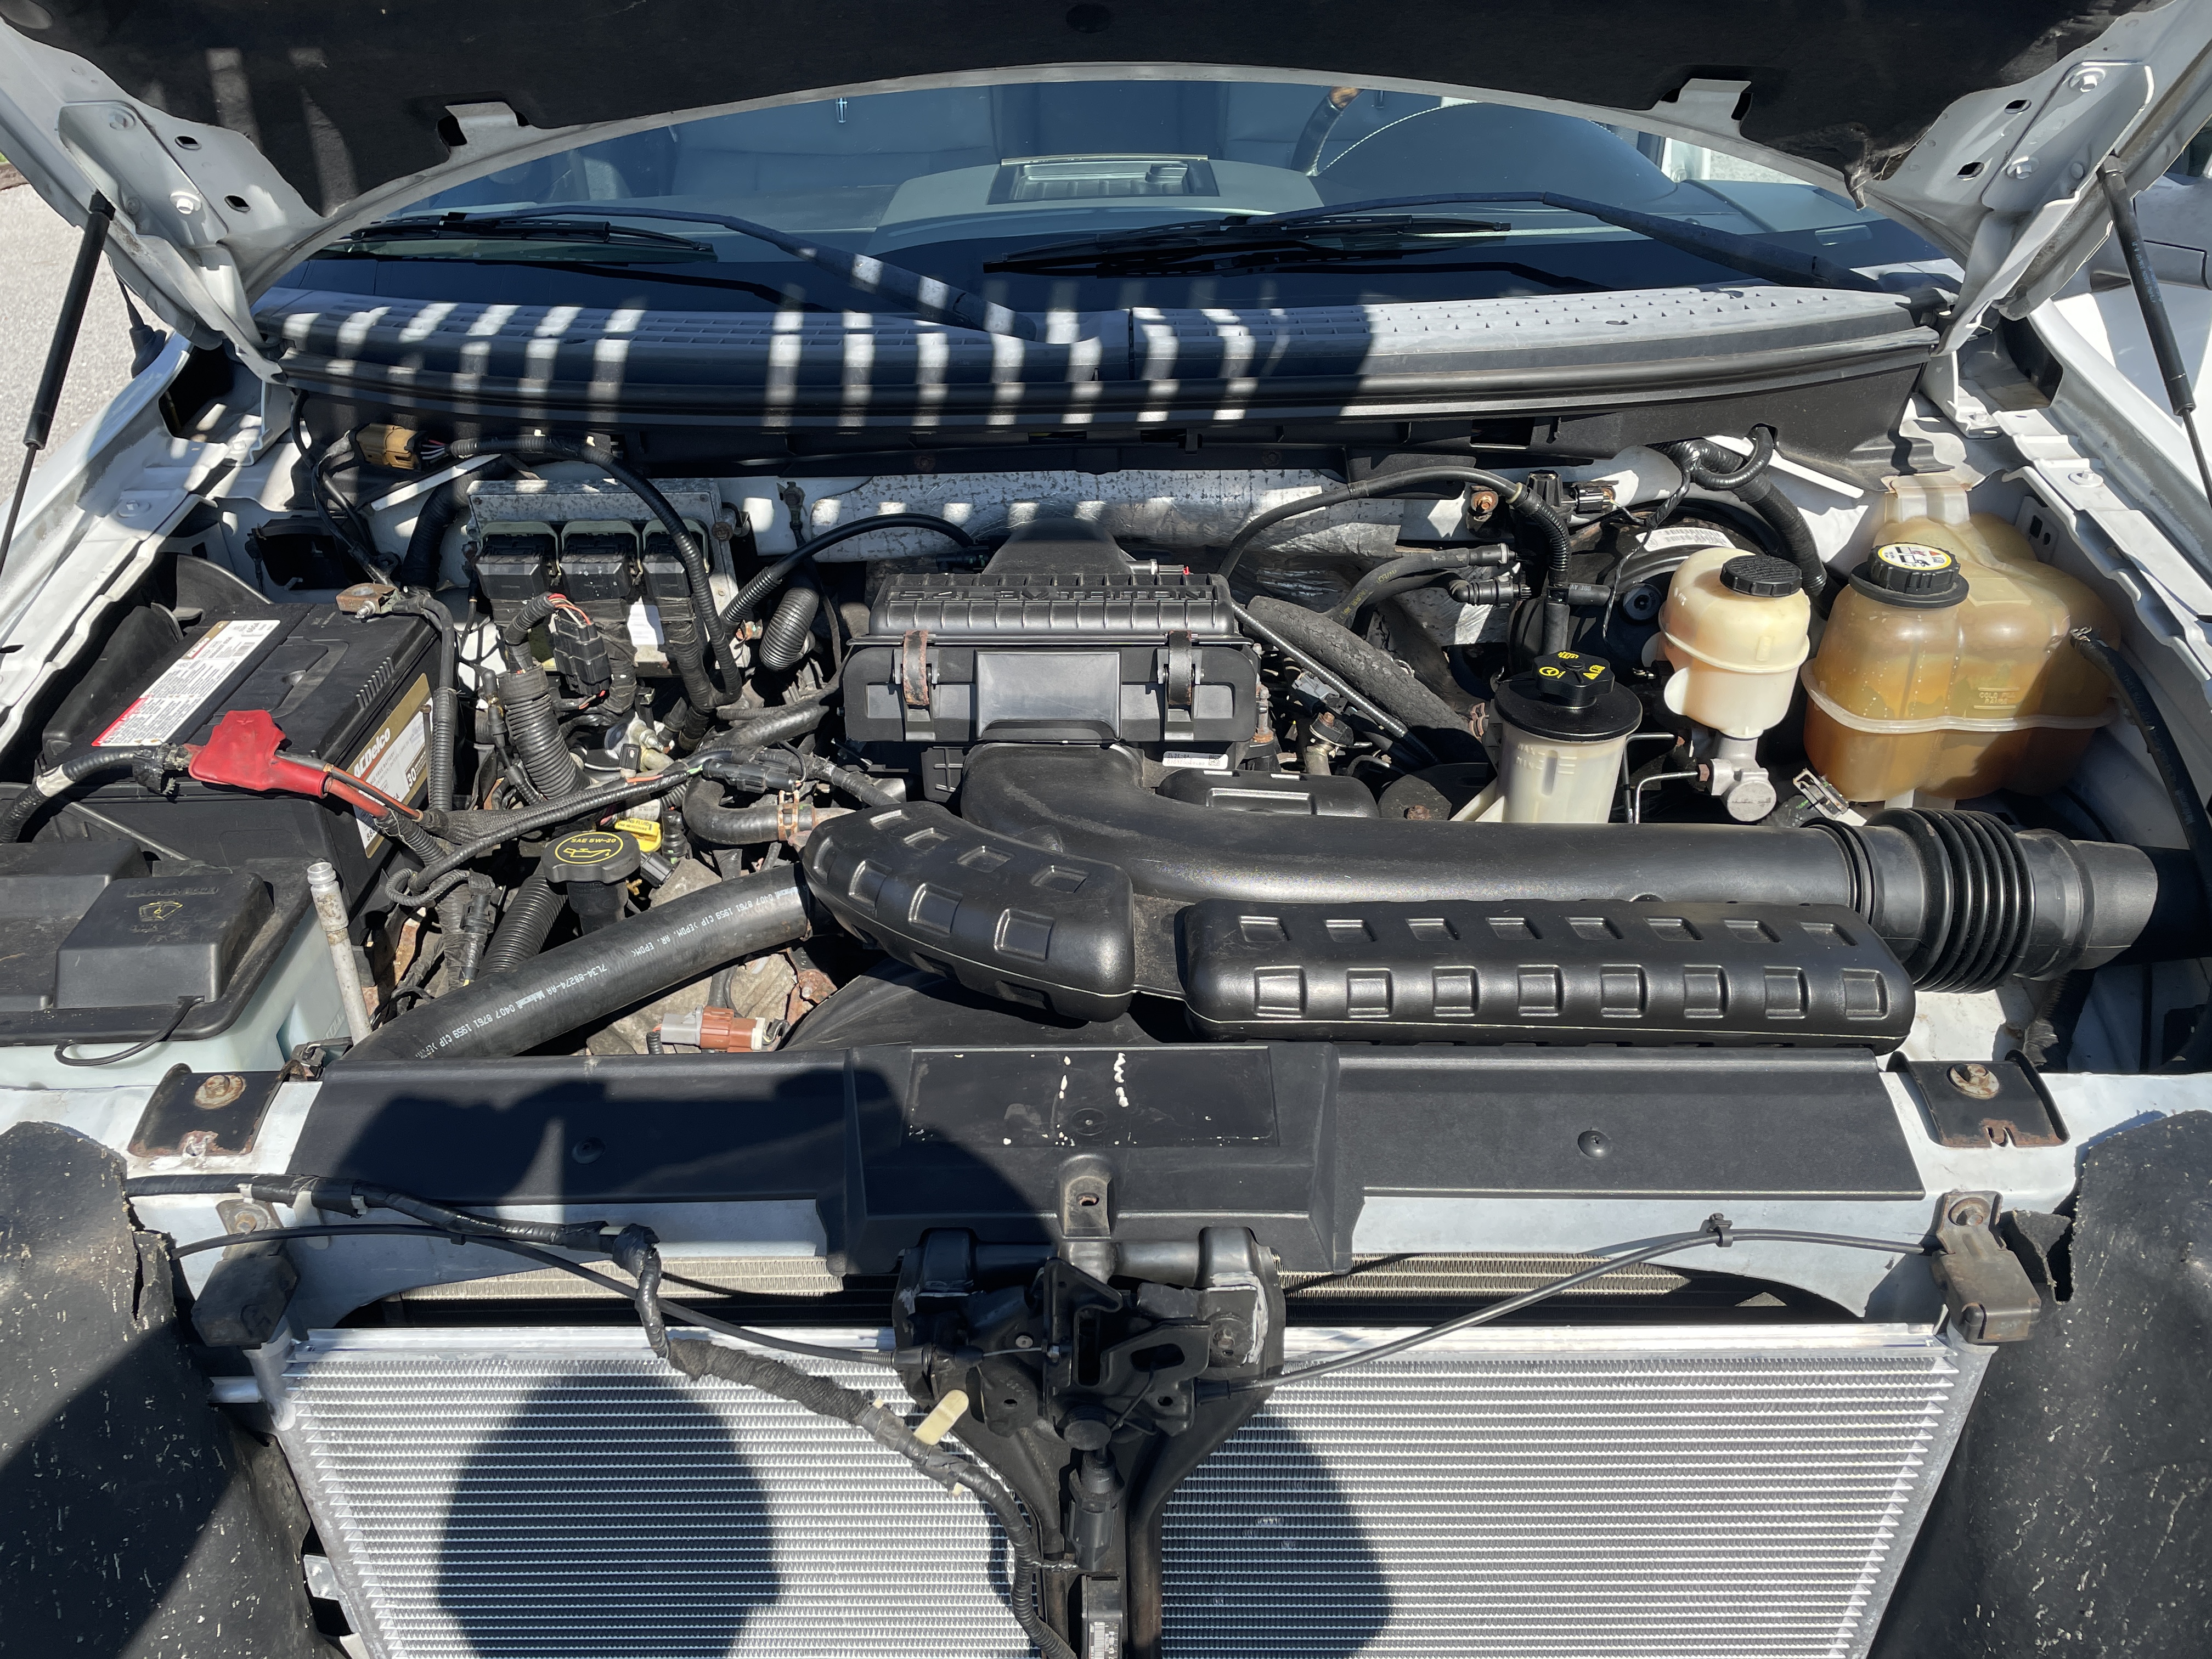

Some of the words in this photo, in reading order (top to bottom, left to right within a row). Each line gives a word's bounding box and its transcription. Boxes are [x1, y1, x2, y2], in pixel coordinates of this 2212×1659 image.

[899, 590, 984, 601] 5.4L
[994, 590, 1049, 601] 3V
[1056, 590, 1206, 601] TRITON
[354, 727, 391, 778] ACDelco
[1517, 743, 1536, 755] MAX
[1516, 756, 1534, 770] MIN
[407, 767, 416, 787] 30
[756, 894, 774, 902] 0407
[715, 907, 733, 920] 1959
[736, 900, 753, 913] 8761
[495, 1004, 516, 1019] 0407
[473, 1013, 493, 1028] 8761
[452, 1023, 472, 1039] 1959
